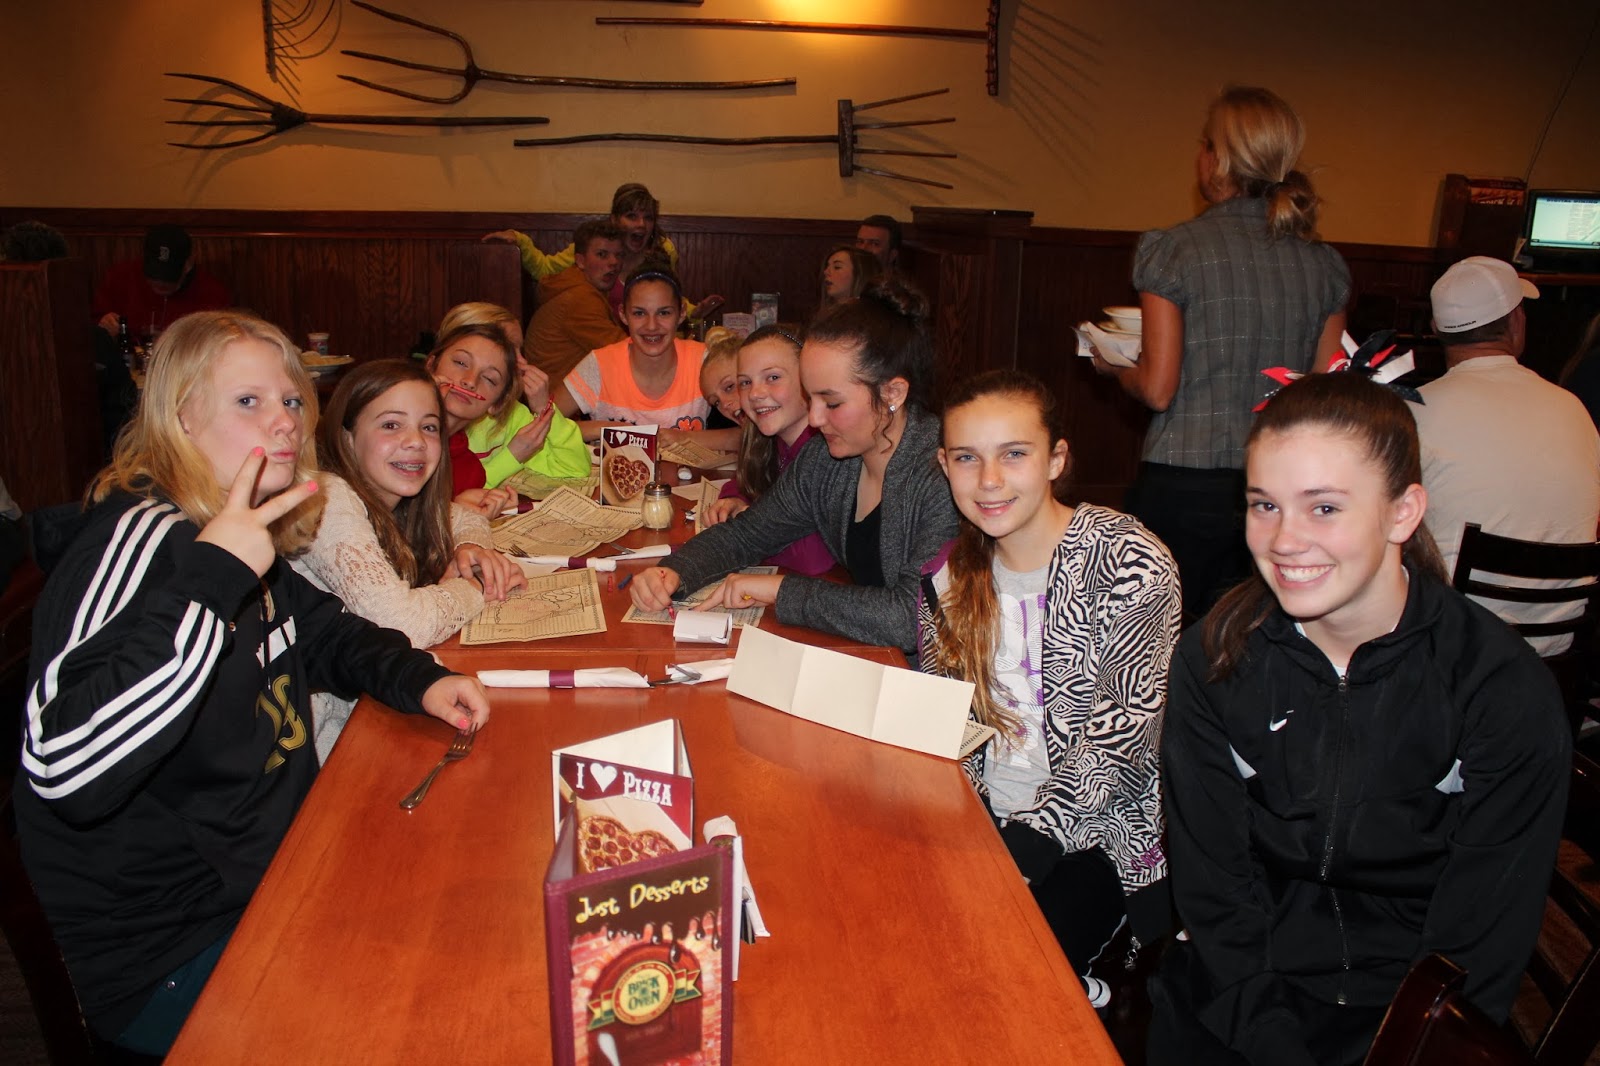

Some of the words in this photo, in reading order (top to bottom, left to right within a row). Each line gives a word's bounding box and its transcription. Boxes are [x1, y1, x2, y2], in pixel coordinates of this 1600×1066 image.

[609, 431, 614, 444] I
[628, 434, 648, 449] PIZZA
[576, 762, 586, 789] I
[622, 771, 672, 806] PIZZA
[575, 897, 620, 923] Just
[630, 876, 710, 909] Desserts
